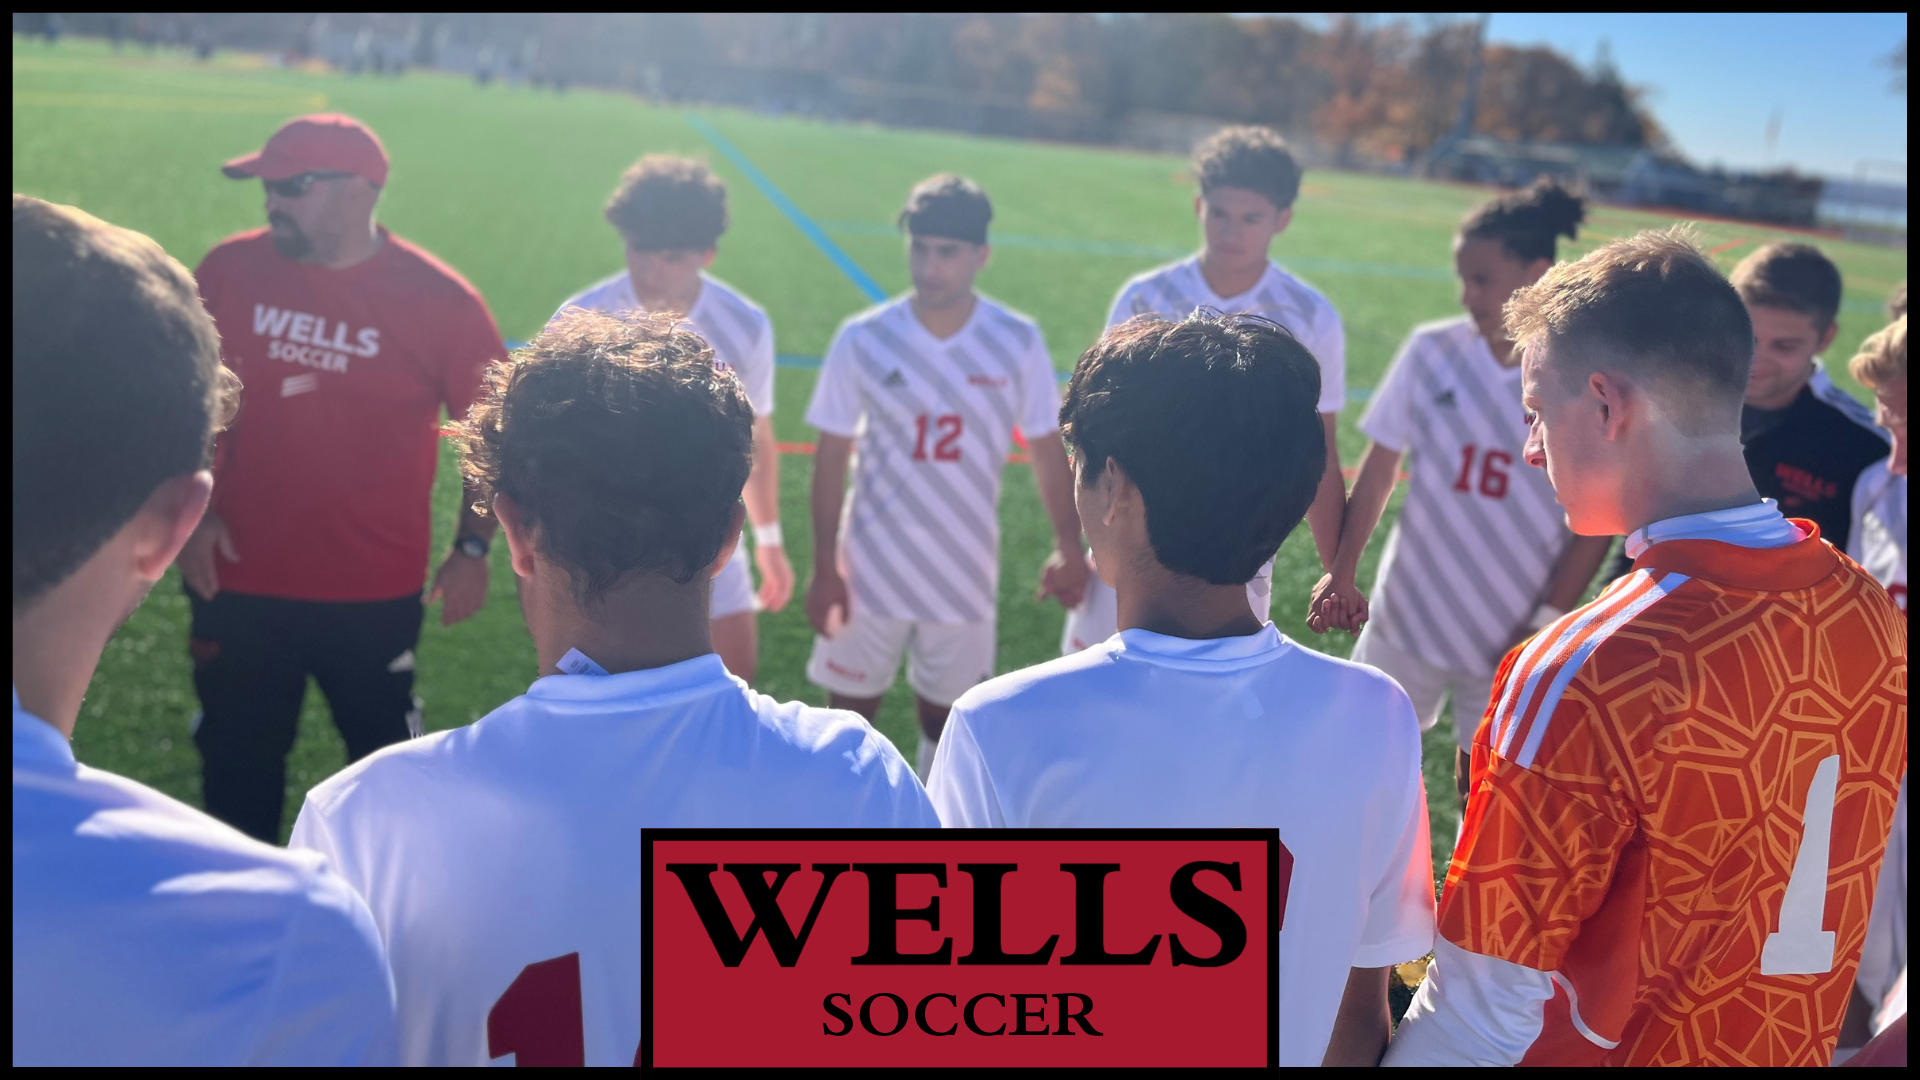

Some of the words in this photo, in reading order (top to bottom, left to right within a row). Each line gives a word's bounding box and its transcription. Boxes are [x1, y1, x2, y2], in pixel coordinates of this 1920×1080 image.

[253, 303, 381, 358] WELLS
[268, 340, 349, 374] SOCCER
[912, 413, 963, 461] 12
[1454, 444, 1513, 500] 16
[1761, 754, 1840, 975] 1
[487, 951, 641, 1067] 1
